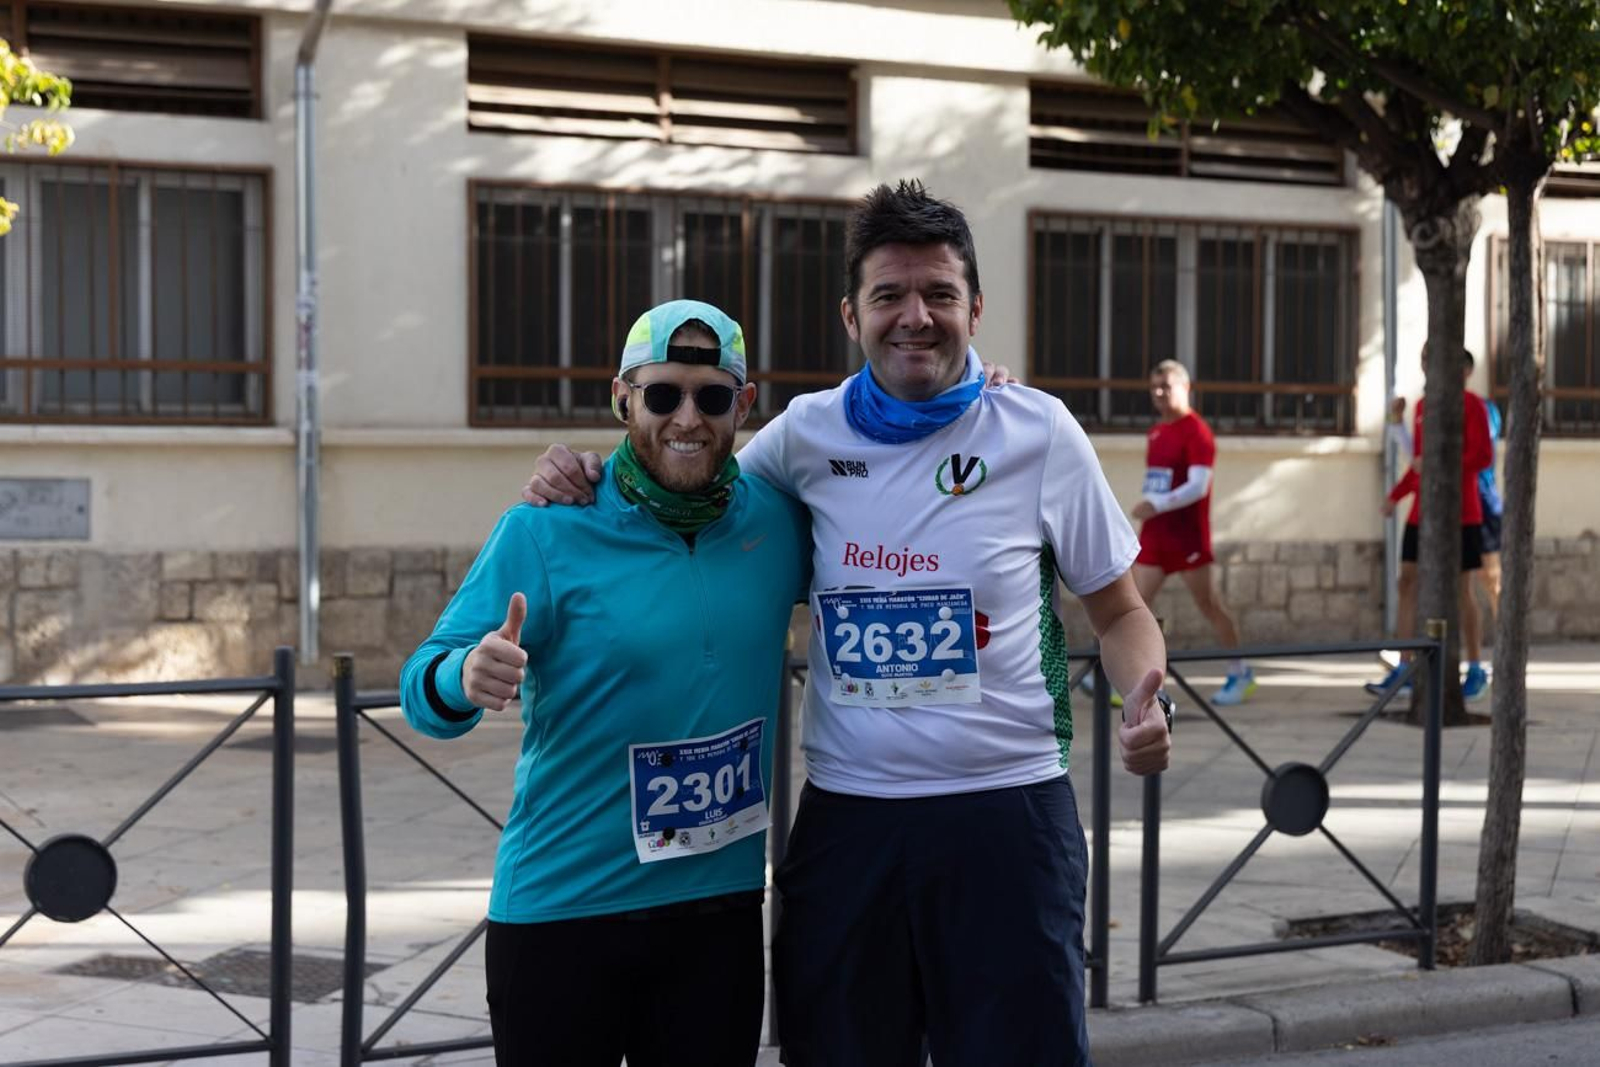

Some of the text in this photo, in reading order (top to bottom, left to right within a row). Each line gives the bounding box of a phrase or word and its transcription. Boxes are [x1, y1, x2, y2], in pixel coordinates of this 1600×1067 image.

[846, 460, 866, 469] RUN
[849, 468, 869, 478] PRO
[842, 541, 940, 578] Relojes
[834, 620, 964, 663] 2632
[875, 662, 919, 674] ANTONIO
[646, 752, 752, 817] 2301
[704, 807, 724, 820] LUIS
